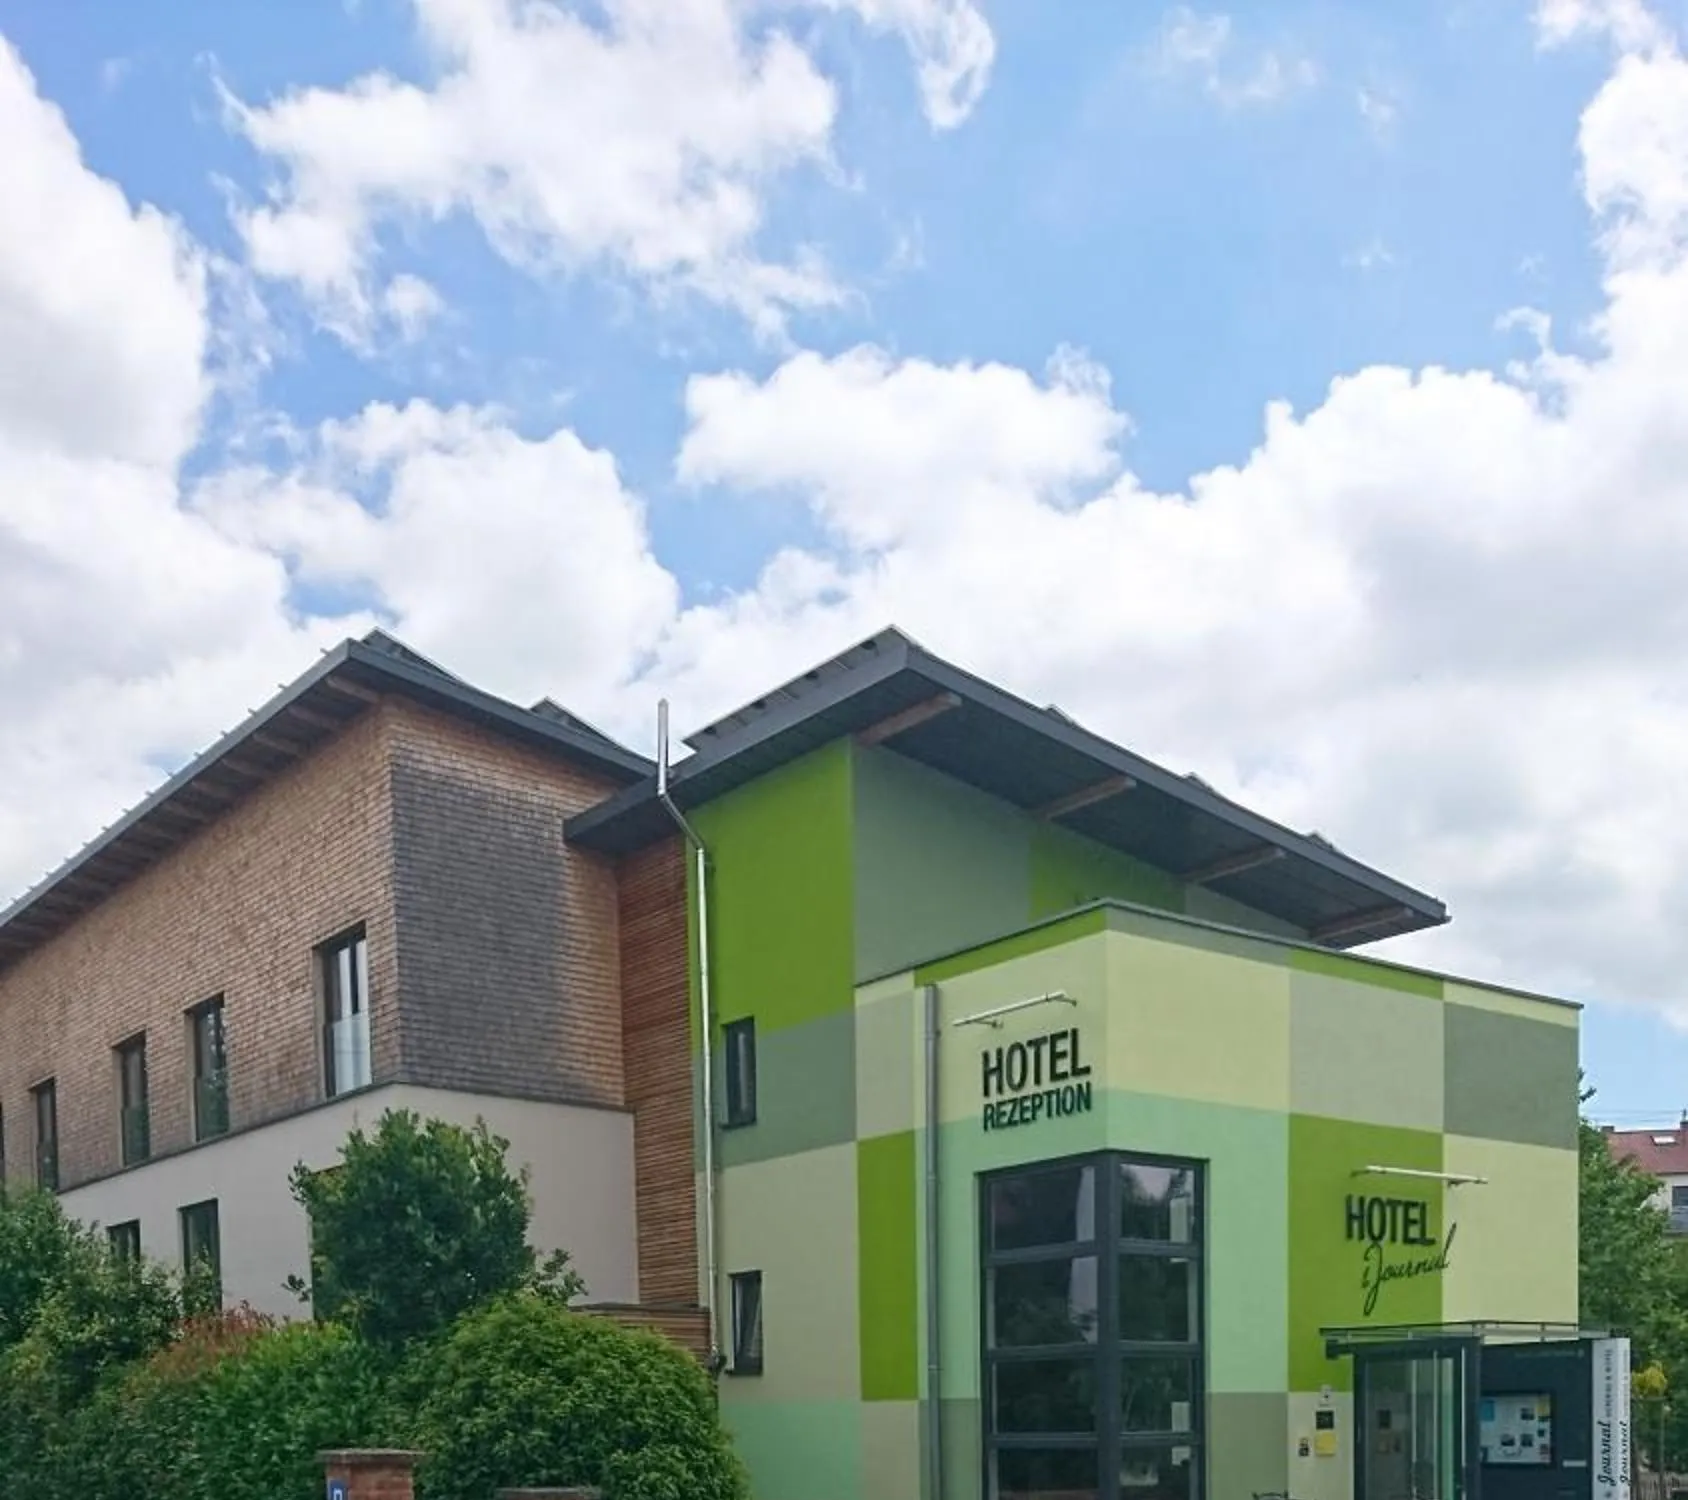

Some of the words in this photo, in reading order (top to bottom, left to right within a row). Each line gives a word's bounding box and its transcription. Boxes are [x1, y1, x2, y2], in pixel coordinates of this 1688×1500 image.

[982, 1028, 1091, 1098] HOTEL
[983, 1081, 1091, 1131] REZEPTION
[1345, 1194, 1436, 1246] HOTEL
[1361, 1221, 1456, 1317] Journal
[1597, 1420, 1616, 1487] Journal
